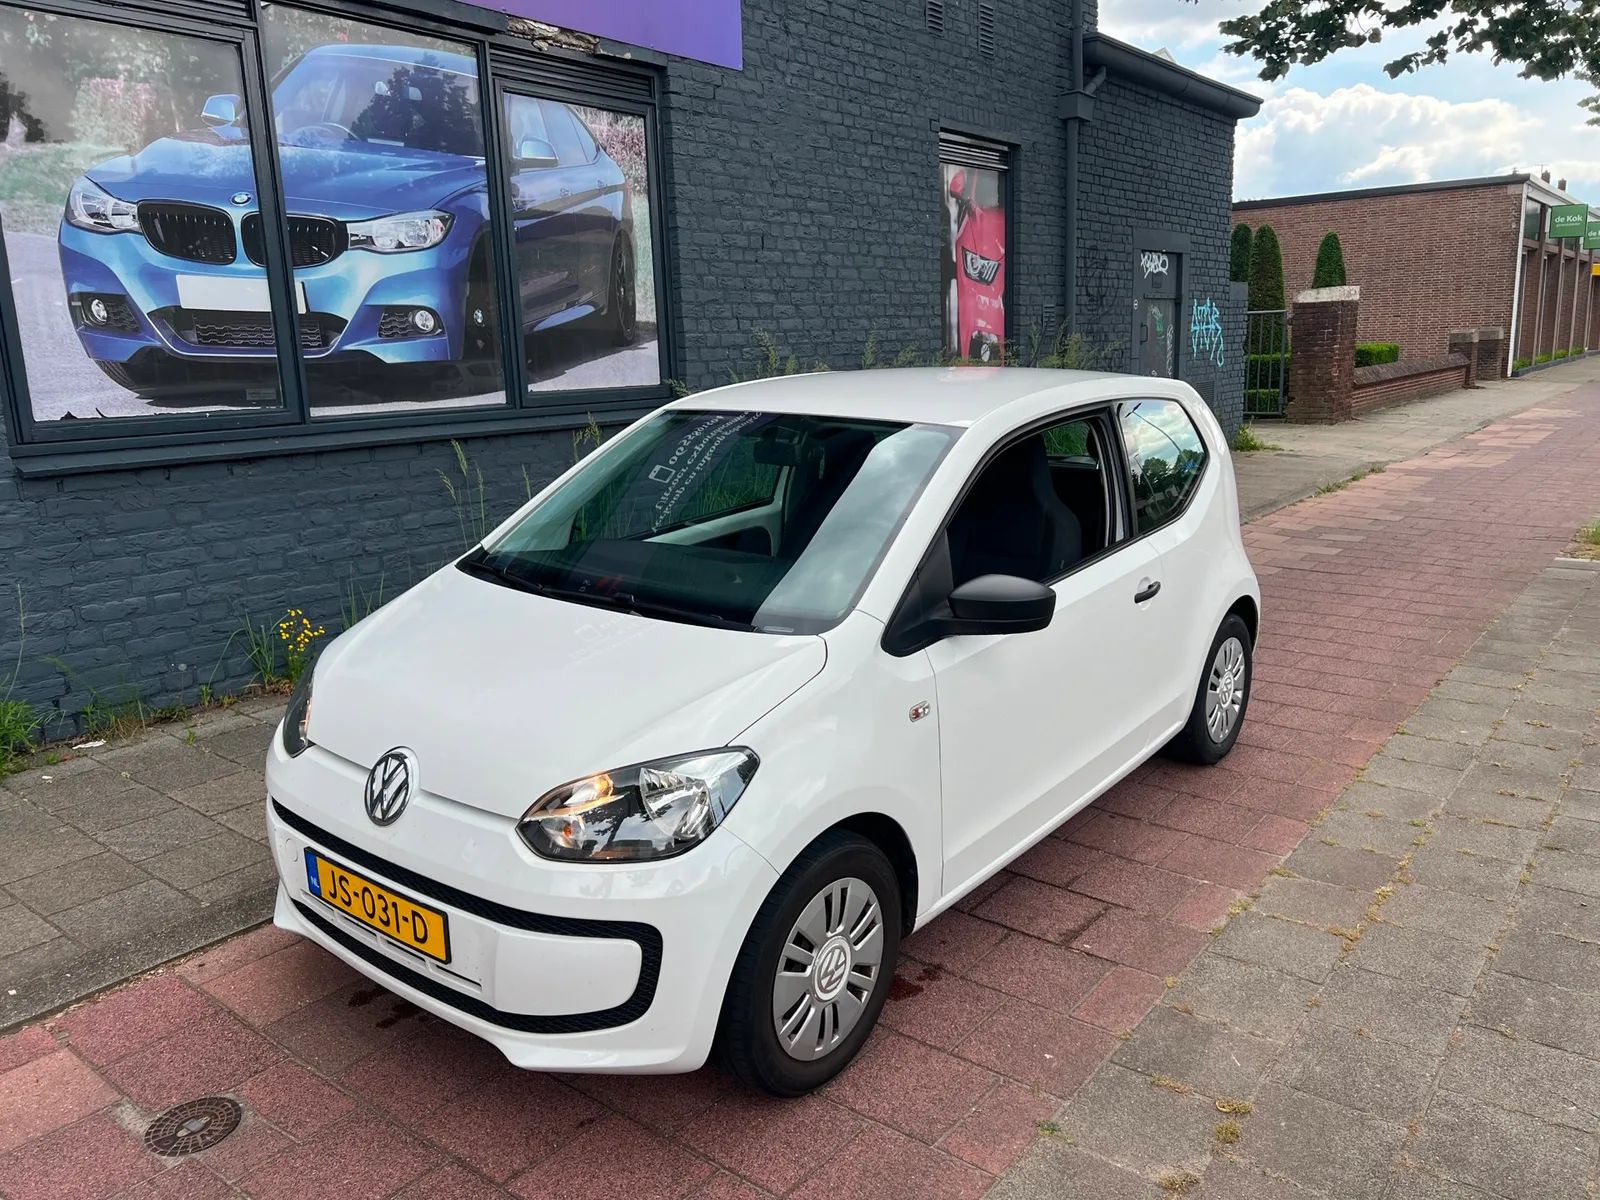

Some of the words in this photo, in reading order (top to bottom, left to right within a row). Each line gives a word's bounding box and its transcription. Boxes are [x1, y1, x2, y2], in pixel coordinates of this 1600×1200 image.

[1554, 215, 1565, 223] de
[1566, 214, 1583, 222] Kok
[310, 875, 320, 888] NL
[329, 869, 429, 944] JS-031-D
